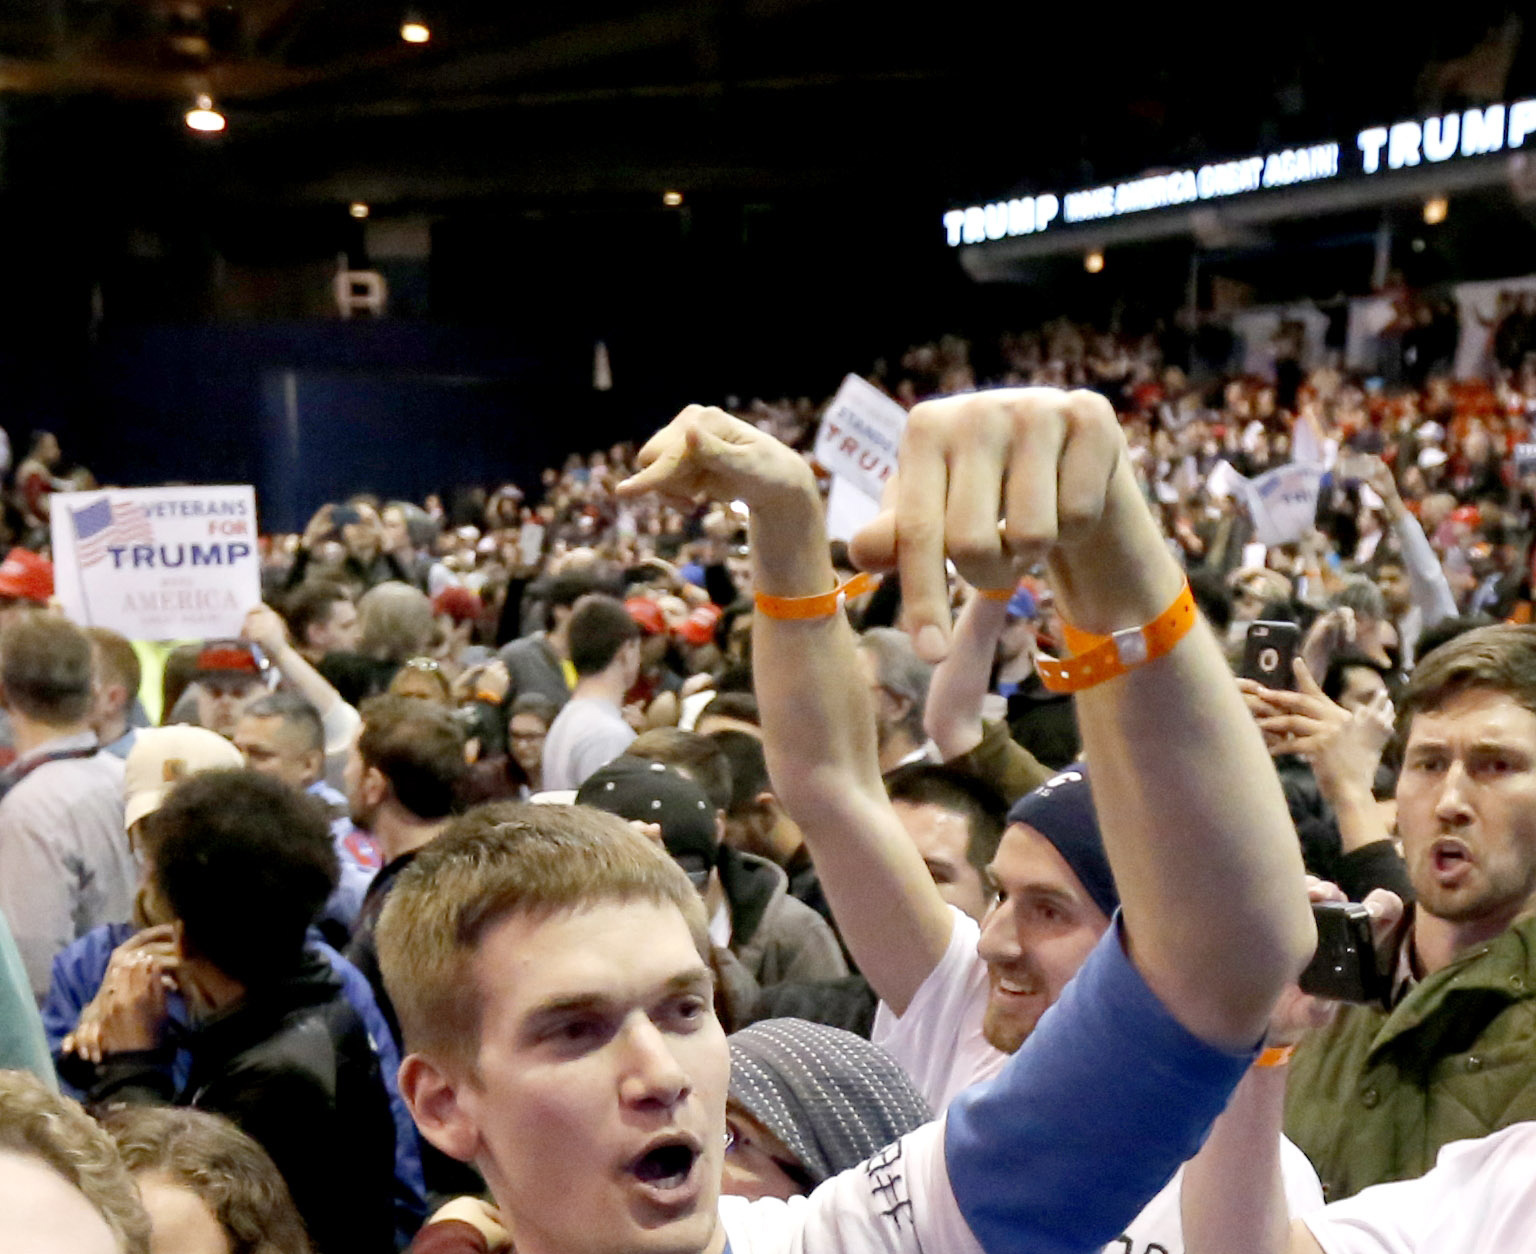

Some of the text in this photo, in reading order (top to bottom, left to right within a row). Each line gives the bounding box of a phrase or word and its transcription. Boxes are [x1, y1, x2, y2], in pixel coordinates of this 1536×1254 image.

[1358, 98, 1536, 174] TRUMP
[944, 194, 1059, 246] TRUMP
[144, 500, 248, 518] VETERANS
[208, 519, 248, 536] FOR
[108, 542, 252, 570] TRUMP
[122, 588, 239, 614] AMERICA
